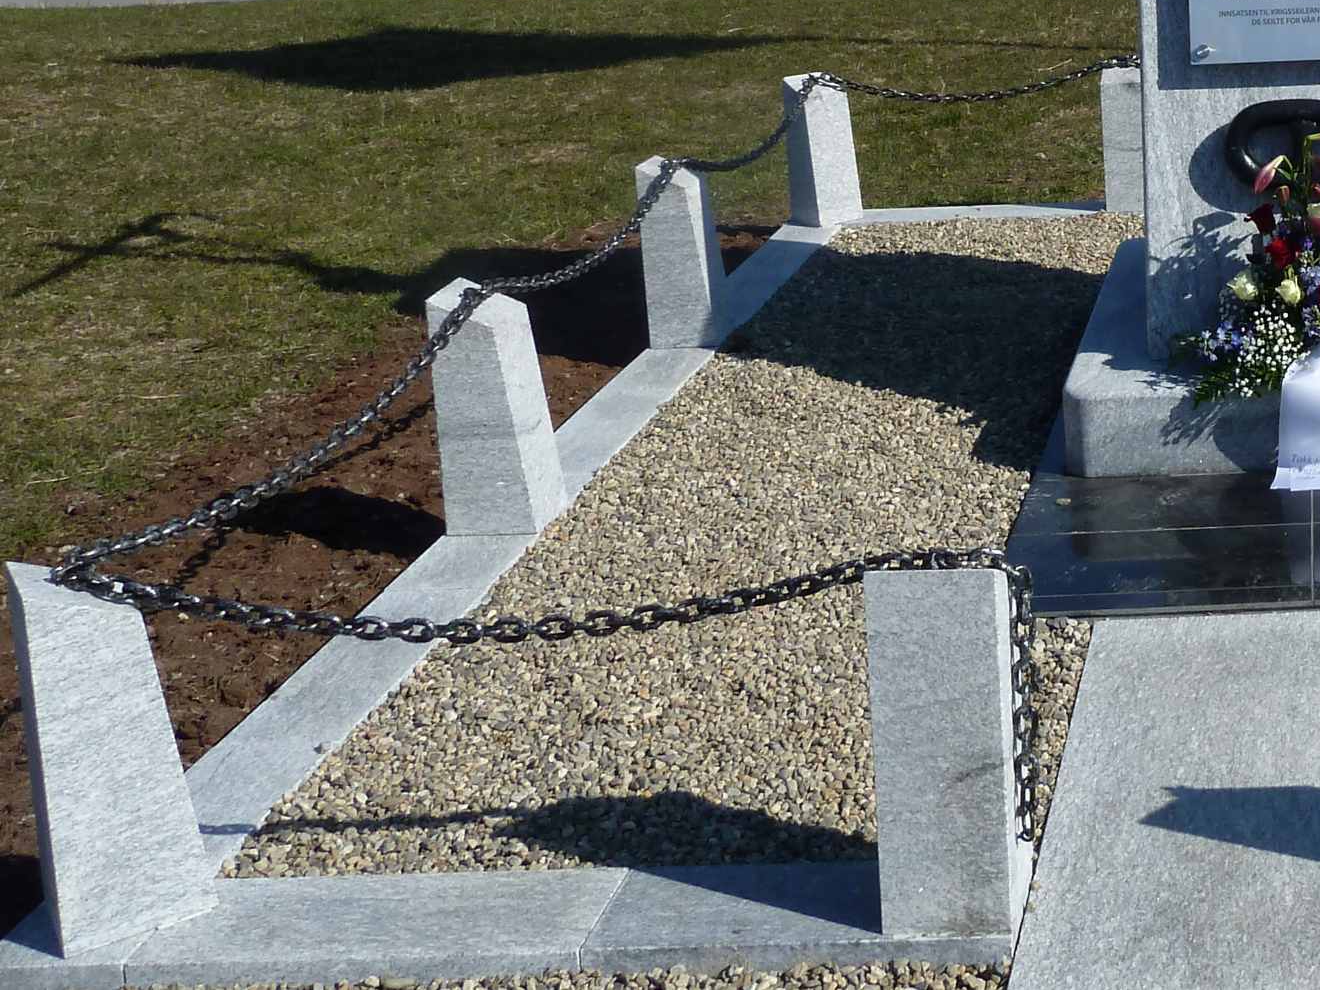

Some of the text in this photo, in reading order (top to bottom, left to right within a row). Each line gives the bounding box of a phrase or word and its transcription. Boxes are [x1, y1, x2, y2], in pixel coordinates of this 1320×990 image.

[1218, 9, 1258, 18] INNSATSEN
[1251, 18, 1261, 26] DE
[1286, 17, 1300, 25] FOR
